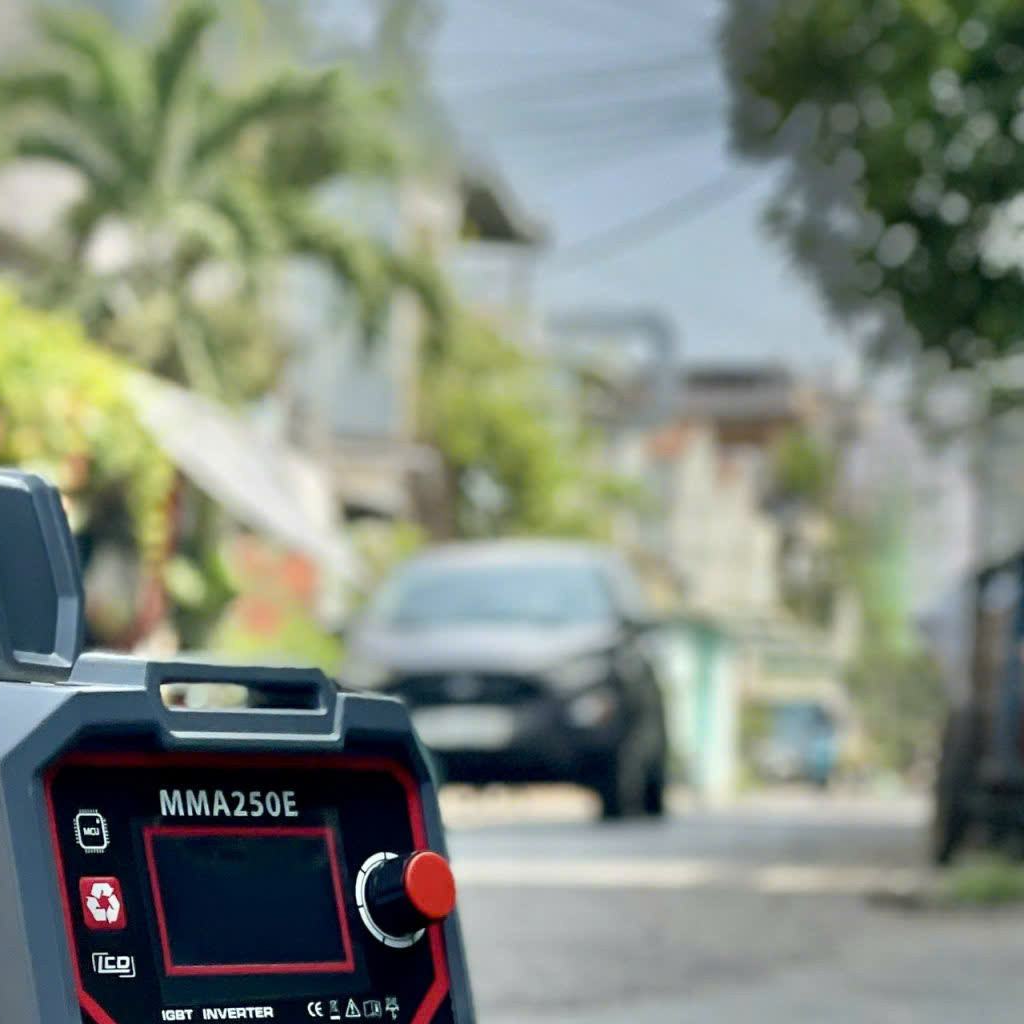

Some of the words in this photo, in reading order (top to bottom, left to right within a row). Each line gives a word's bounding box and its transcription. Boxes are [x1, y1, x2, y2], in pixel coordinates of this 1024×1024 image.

[159, 788, 299, 818] MMA250E
[97, 955, 131, 975] LCD
[161, 1008, 194, 1021] IGBT
[202, 1006, 274, 1020] INVERTER
